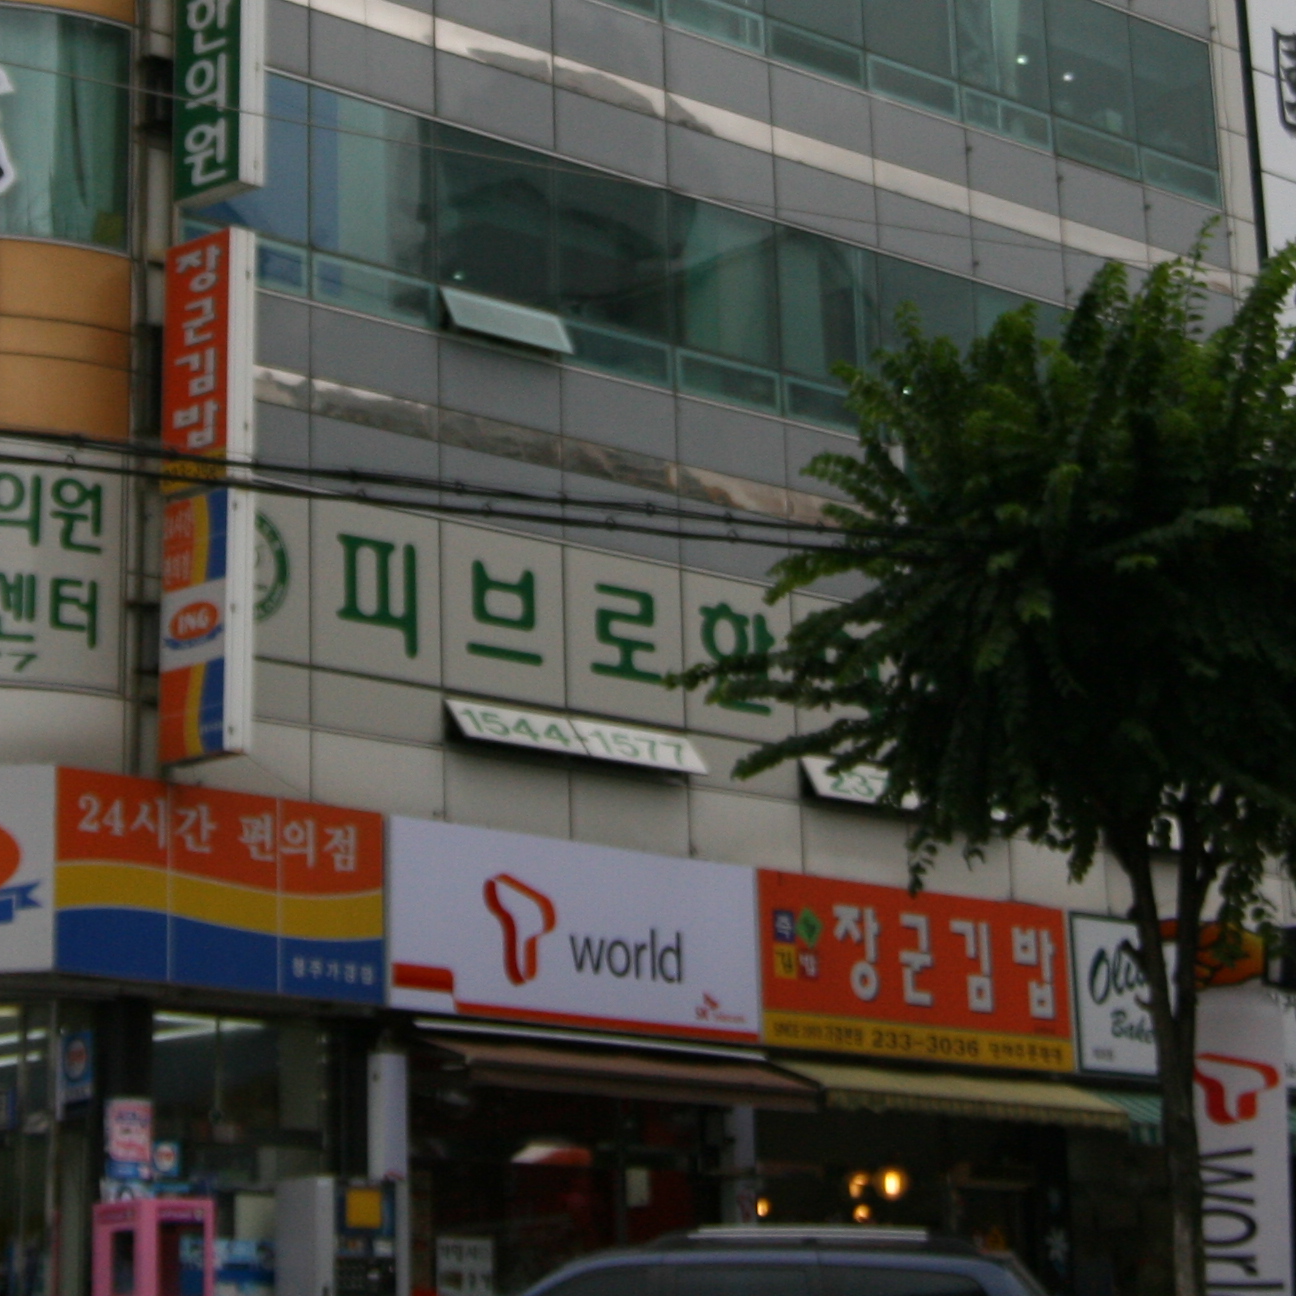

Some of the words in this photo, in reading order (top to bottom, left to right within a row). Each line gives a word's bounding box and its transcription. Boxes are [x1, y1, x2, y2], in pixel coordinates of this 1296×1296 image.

[172, 245, 220, 450] 장군김밥
[177, 610, 211, 635] ING
[460, 707, 685, 765] 1544-1577
[77, 793, 217, 854] 24시간
[240, 814, 359, 872] 편의점
[569, 927, 684, 985] world
[832, 903, 1056, 1020] 장군김밥
[872, 1027, 980, 1058] 233-3036
[1196, 1147, 1285, 1294] worl
